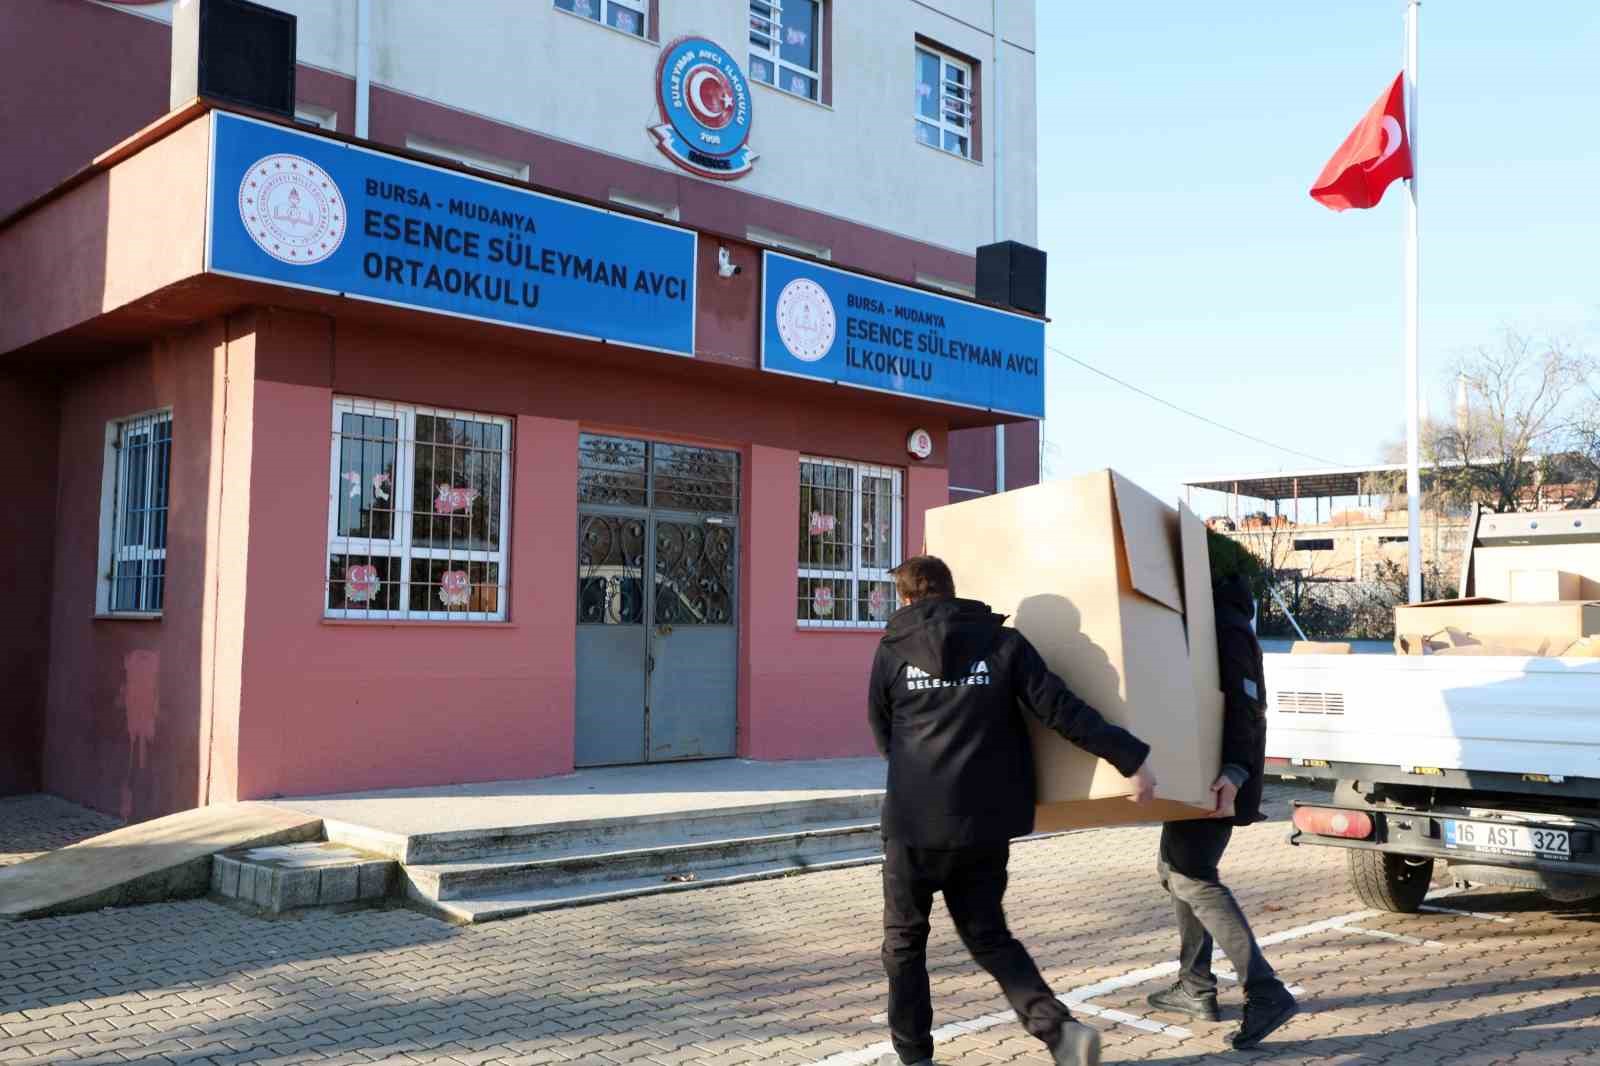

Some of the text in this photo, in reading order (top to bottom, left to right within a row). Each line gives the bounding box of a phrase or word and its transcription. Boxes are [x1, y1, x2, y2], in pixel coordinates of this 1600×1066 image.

[365, 178, 431, 210] BURSA
[449, 198, 536, 234] MUDANYA
[363, 252, 540, 309] ORTAOKULU
[364, 208, 480, 259] ESENCE
[487, 232, 628, 289] SÜLEYMAN
[633, 270, 686, 301] AVCI
[847, 293, 885, 315] BURSA
[895, 305, 945, 329] MUDANYA
[846, 317, 912, 351] ESENCE
[918, 330, 1002, 368] SÜLEYMAN
[1006, 353, 1039, 377] AVCI
[846, 341, 932, 382] İLKOKULU
[1457, 824, 1474, 842] 16
[1488, 826, 1519, 847] AST
[1534, 830, 1567, 853] 322
